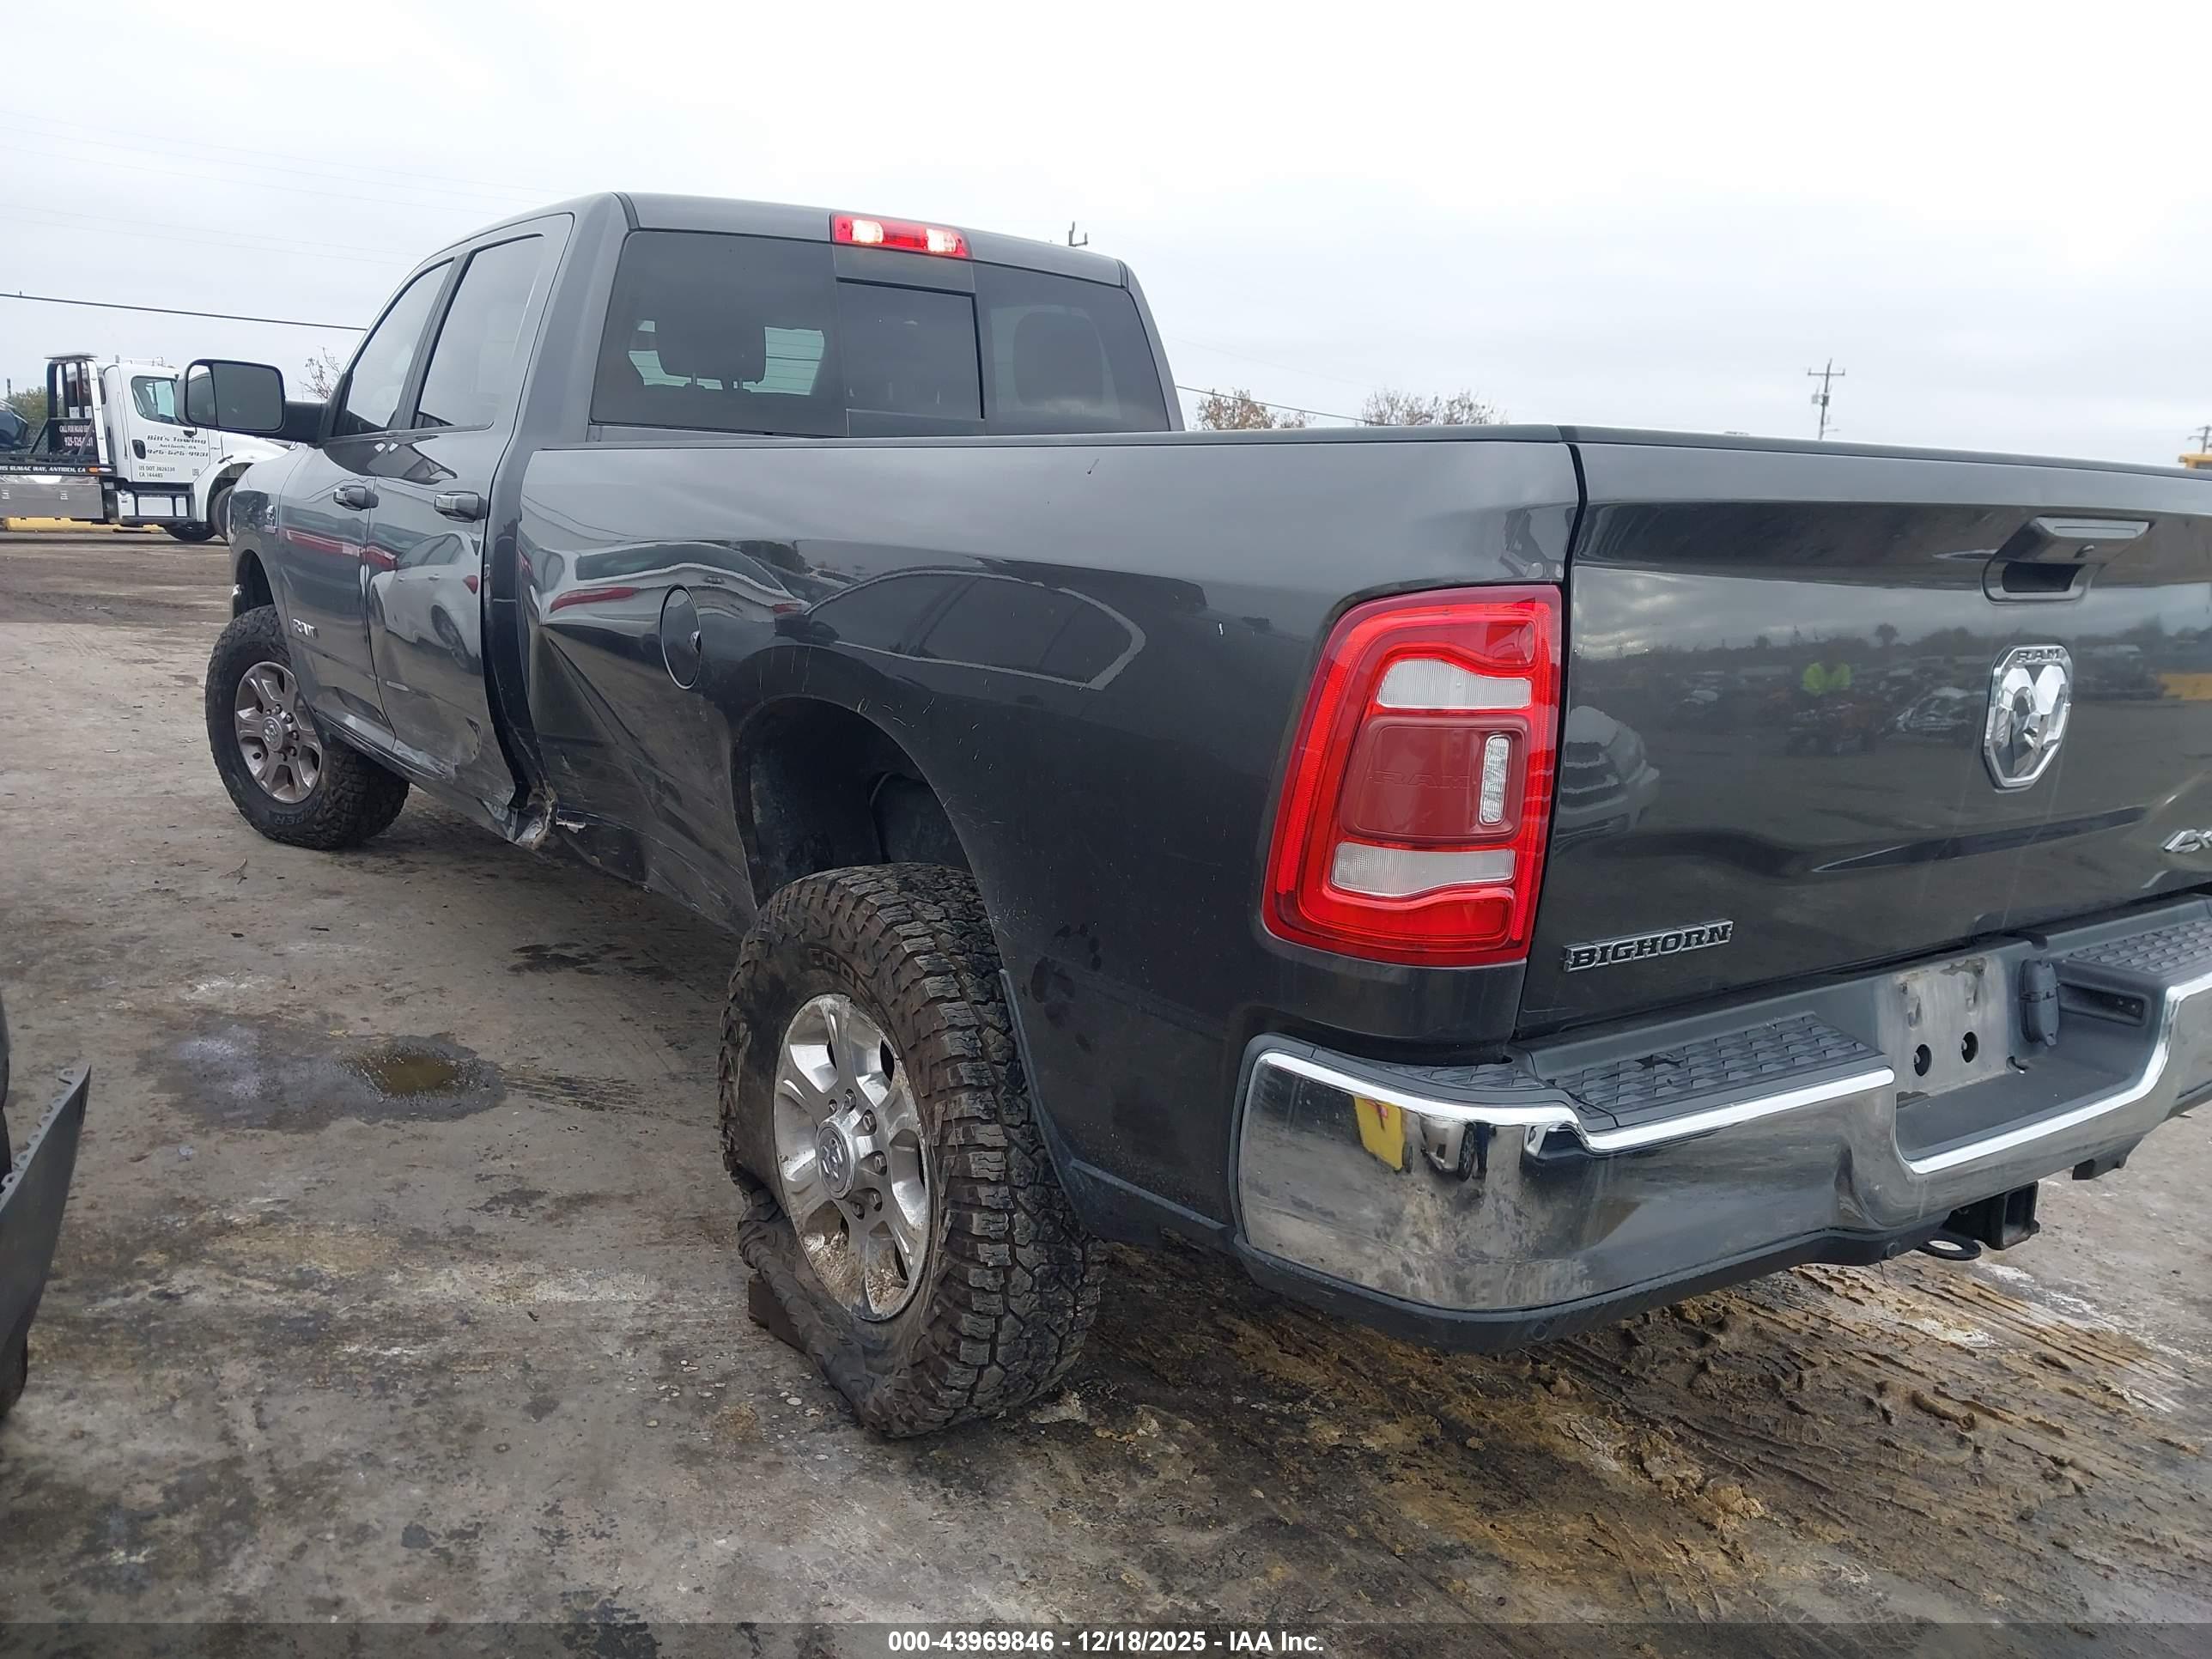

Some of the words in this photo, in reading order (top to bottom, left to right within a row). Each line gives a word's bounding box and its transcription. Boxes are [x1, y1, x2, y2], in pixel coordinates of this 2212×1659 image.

[2016, 648, 2061, 663] RAM
[1366, 769, 1472, 791] RAM
[1562, 918, 1735, 973] BIGHORN
